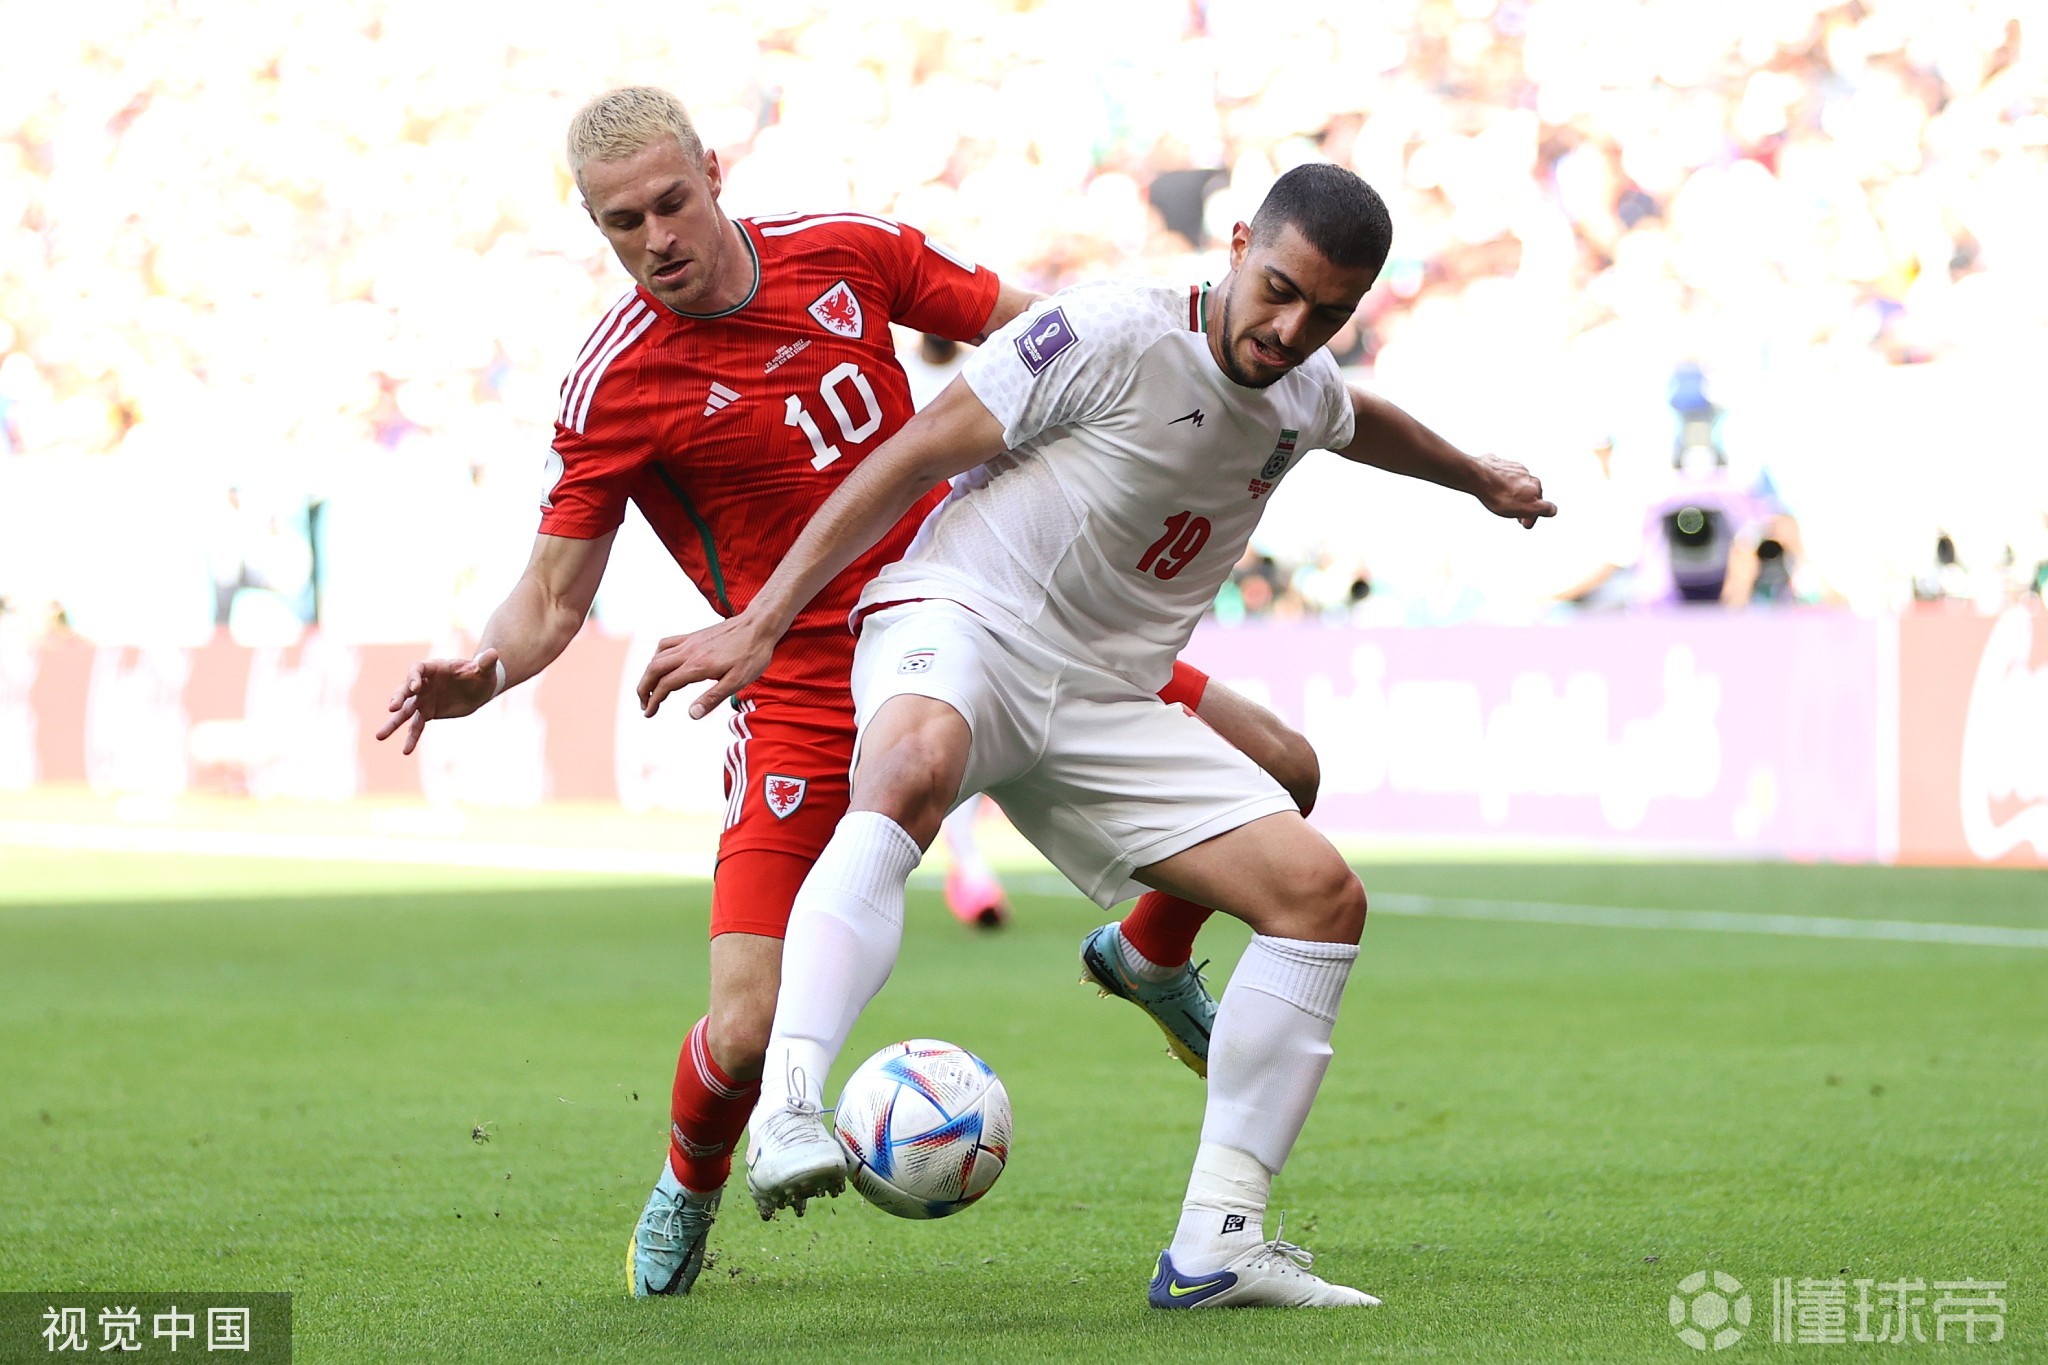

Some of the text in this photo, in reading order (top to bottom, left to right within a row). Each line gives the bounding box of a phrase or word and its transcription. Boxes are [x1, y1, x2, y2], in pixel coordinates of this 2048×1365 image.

[784, 362, 883, 472] 10
[1136, 510, 1211, 580] 19
[1225, 1216, 1244, 1231] FS
